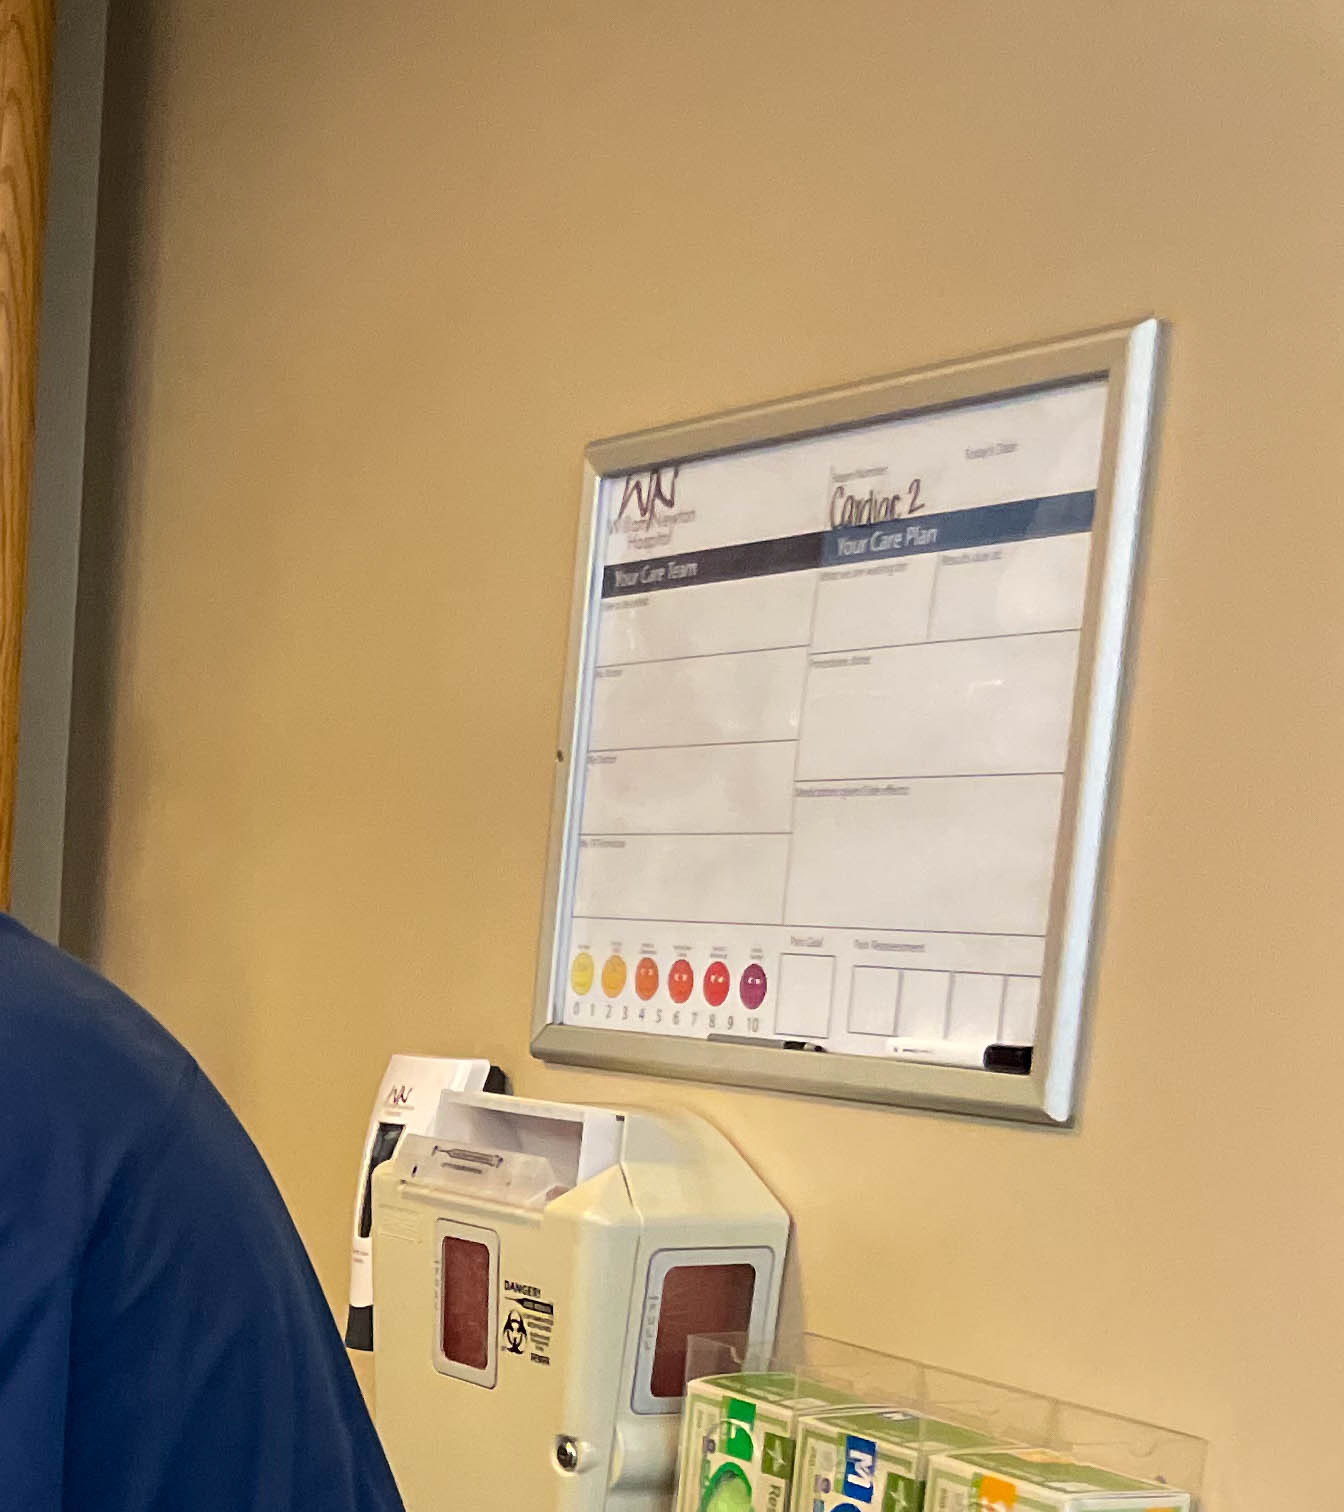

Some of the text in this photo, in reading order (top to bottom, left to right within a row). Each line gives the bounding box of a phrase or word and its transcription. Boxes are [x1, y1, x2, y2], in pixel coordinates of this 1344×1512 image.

[907, 478, 926, 514] 2
[836, 526, 938, 556] Your Care Plan
[615, 561, 699, 587] Your Care Team
[573, 1001, 759, 1032] 0 1 2 3 4 5 6 7 8 9 10
[846, 1449, 874, 1489] M
